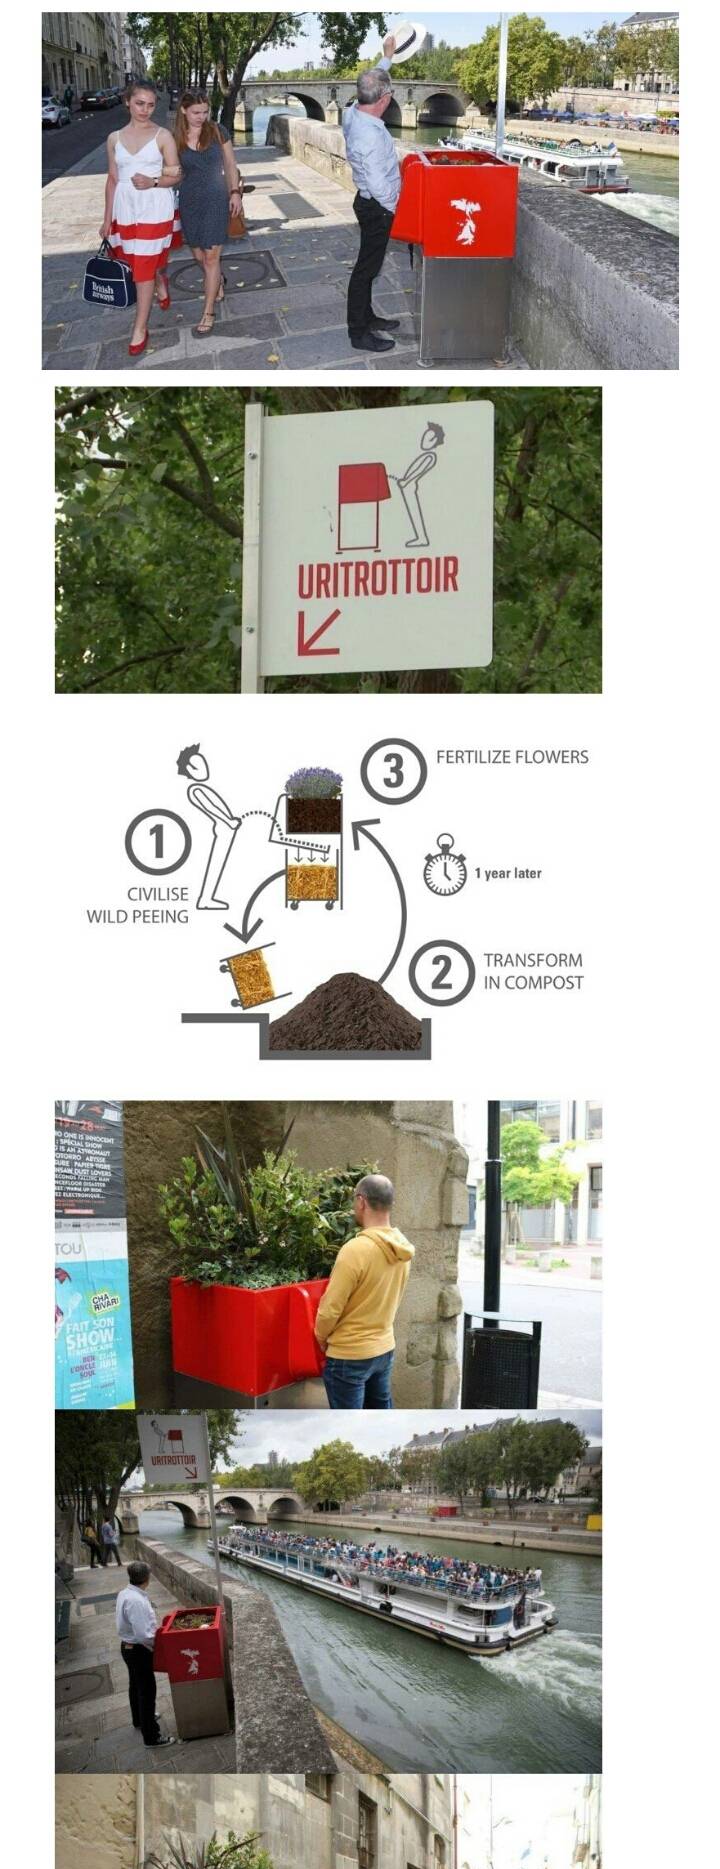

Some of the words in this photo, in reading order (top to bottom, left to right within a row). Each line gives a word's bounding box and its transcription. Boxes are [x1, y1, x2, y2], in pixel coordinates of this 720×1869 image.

[298, 556, 459, 599] URITROTTOIR
[437, 750, 511, 764] FERTILIZE
[515, 750, 589, 764] FLOWERS
[383, 752, 404, 789] 3
[149, 823, 164, 859] 1
[475, 867, 481, 879] 1
[484, 869, 512, 882] year
[514, 867, 542, 879] later
[127, 887, 189, 902] CIVILISE
[86, 909, 128, 924] WILD
[132, 909, 189, 924] PEEING
[484, 953, 583, 968] TRANSFORM
[431, 954, 453, 990] 2
[484, 975, 500, 990] IN
[504, 975, 585, 990] COMPOST
[64, 1132, 78, 1140] ONE
[92, 1293, 109, 1305] CHA
[93, 1297, 120, 1312] RIVARI
[66, 1320, 90, 1335] FAIT
[92, 1316, 115, 1329] SON
[151, 1454, 197, 1467] URITROTTOIR
